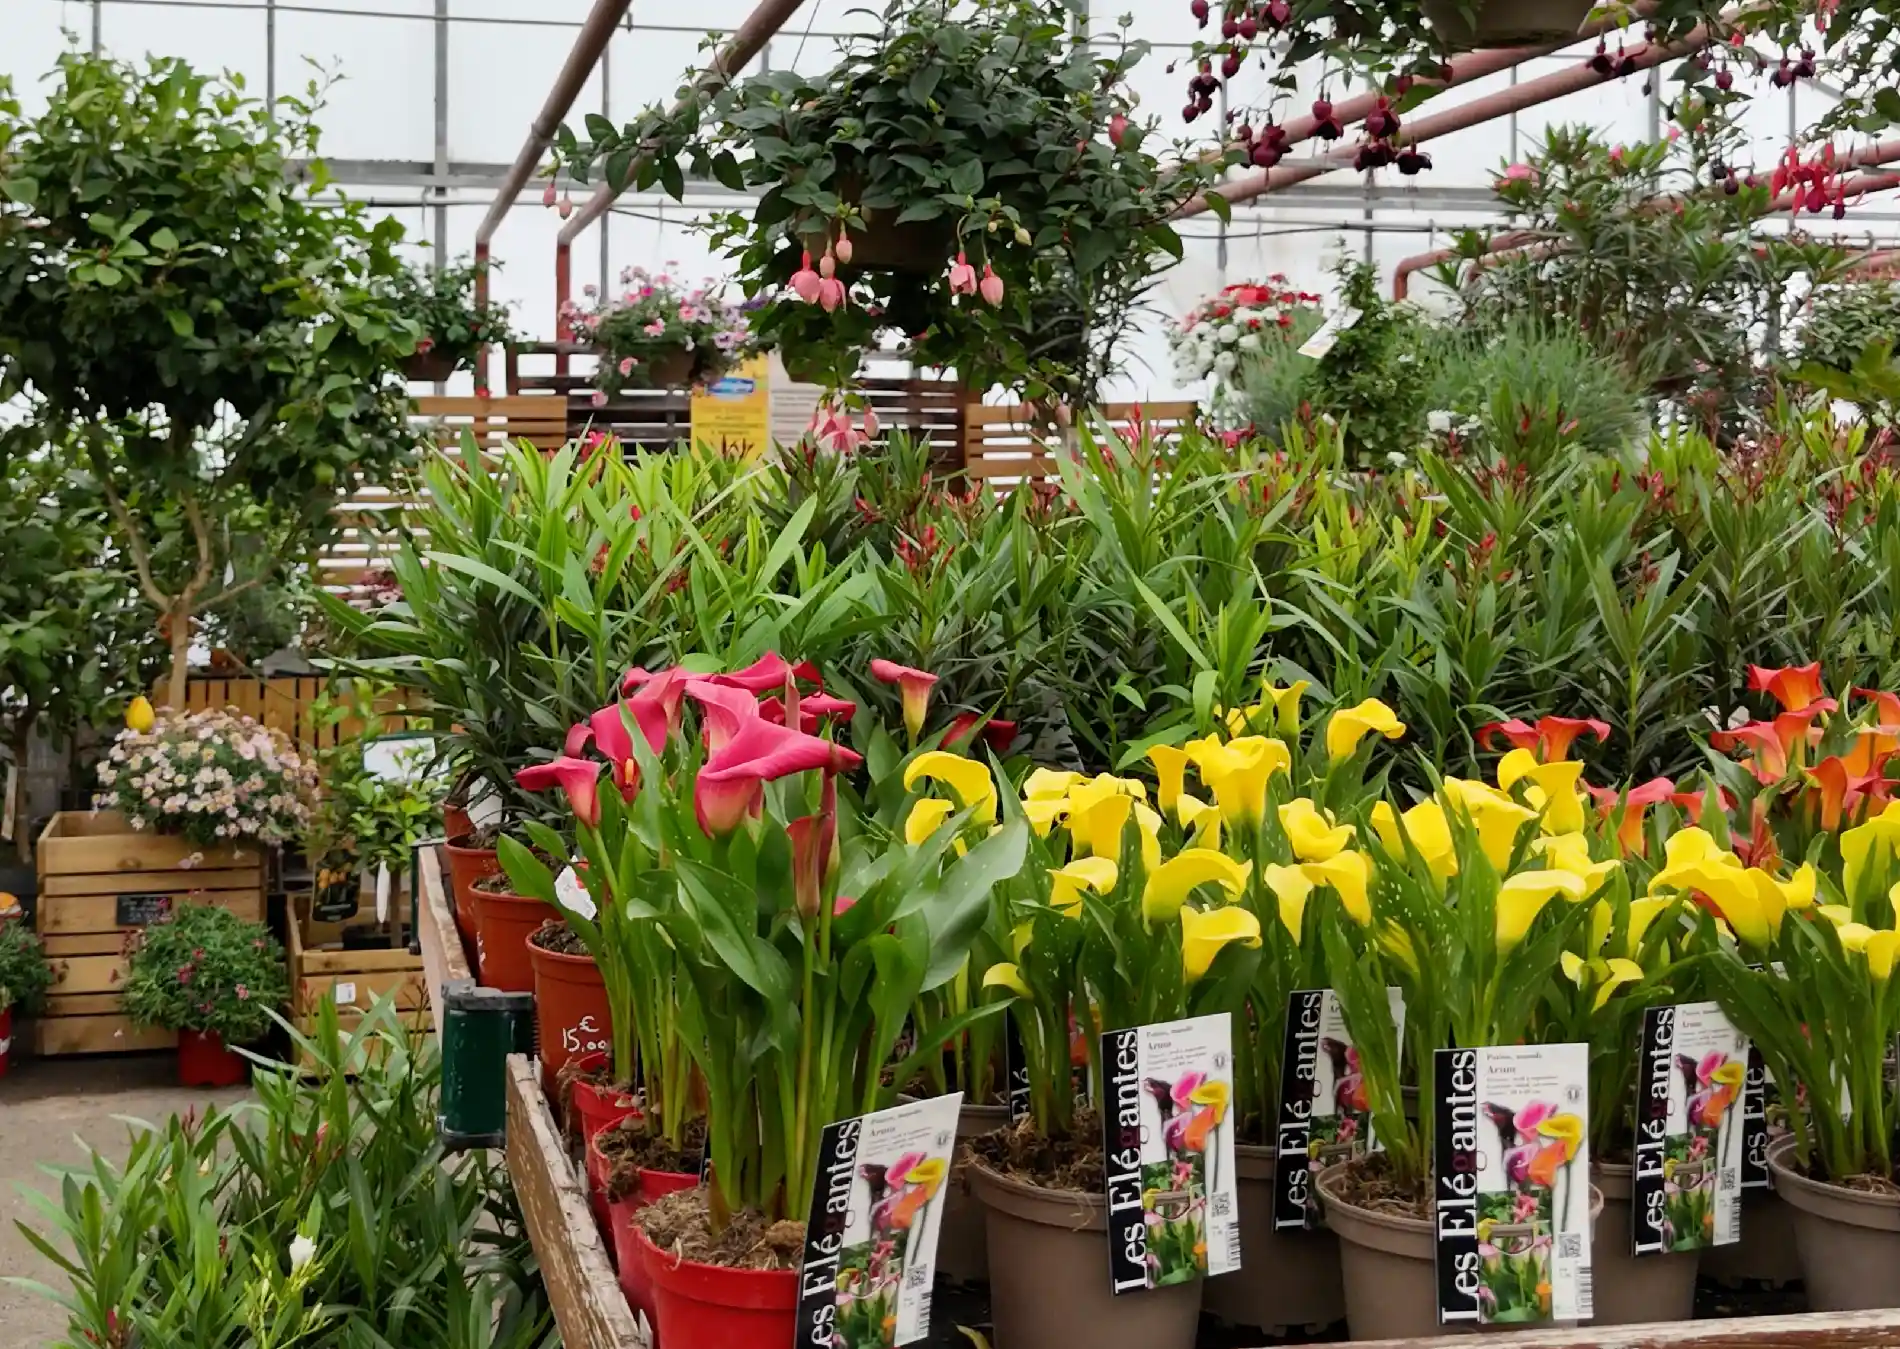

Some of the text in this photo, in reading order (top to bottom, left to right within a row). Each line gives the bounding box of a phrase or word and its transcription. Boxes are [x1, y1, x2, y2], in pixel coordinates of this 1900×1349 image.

[1107, 1030, 1150, 1294] Les Elégantes
[1276, 1168, 1309, 1230] Les
[1437, 1049, 1487, 1323] Les Elégantes
[1635, 1007, 1675, 1255] Les Elégantes
[1740, 1131, 1769, 1189] Les
[810, 1303, 837, 1349] es
